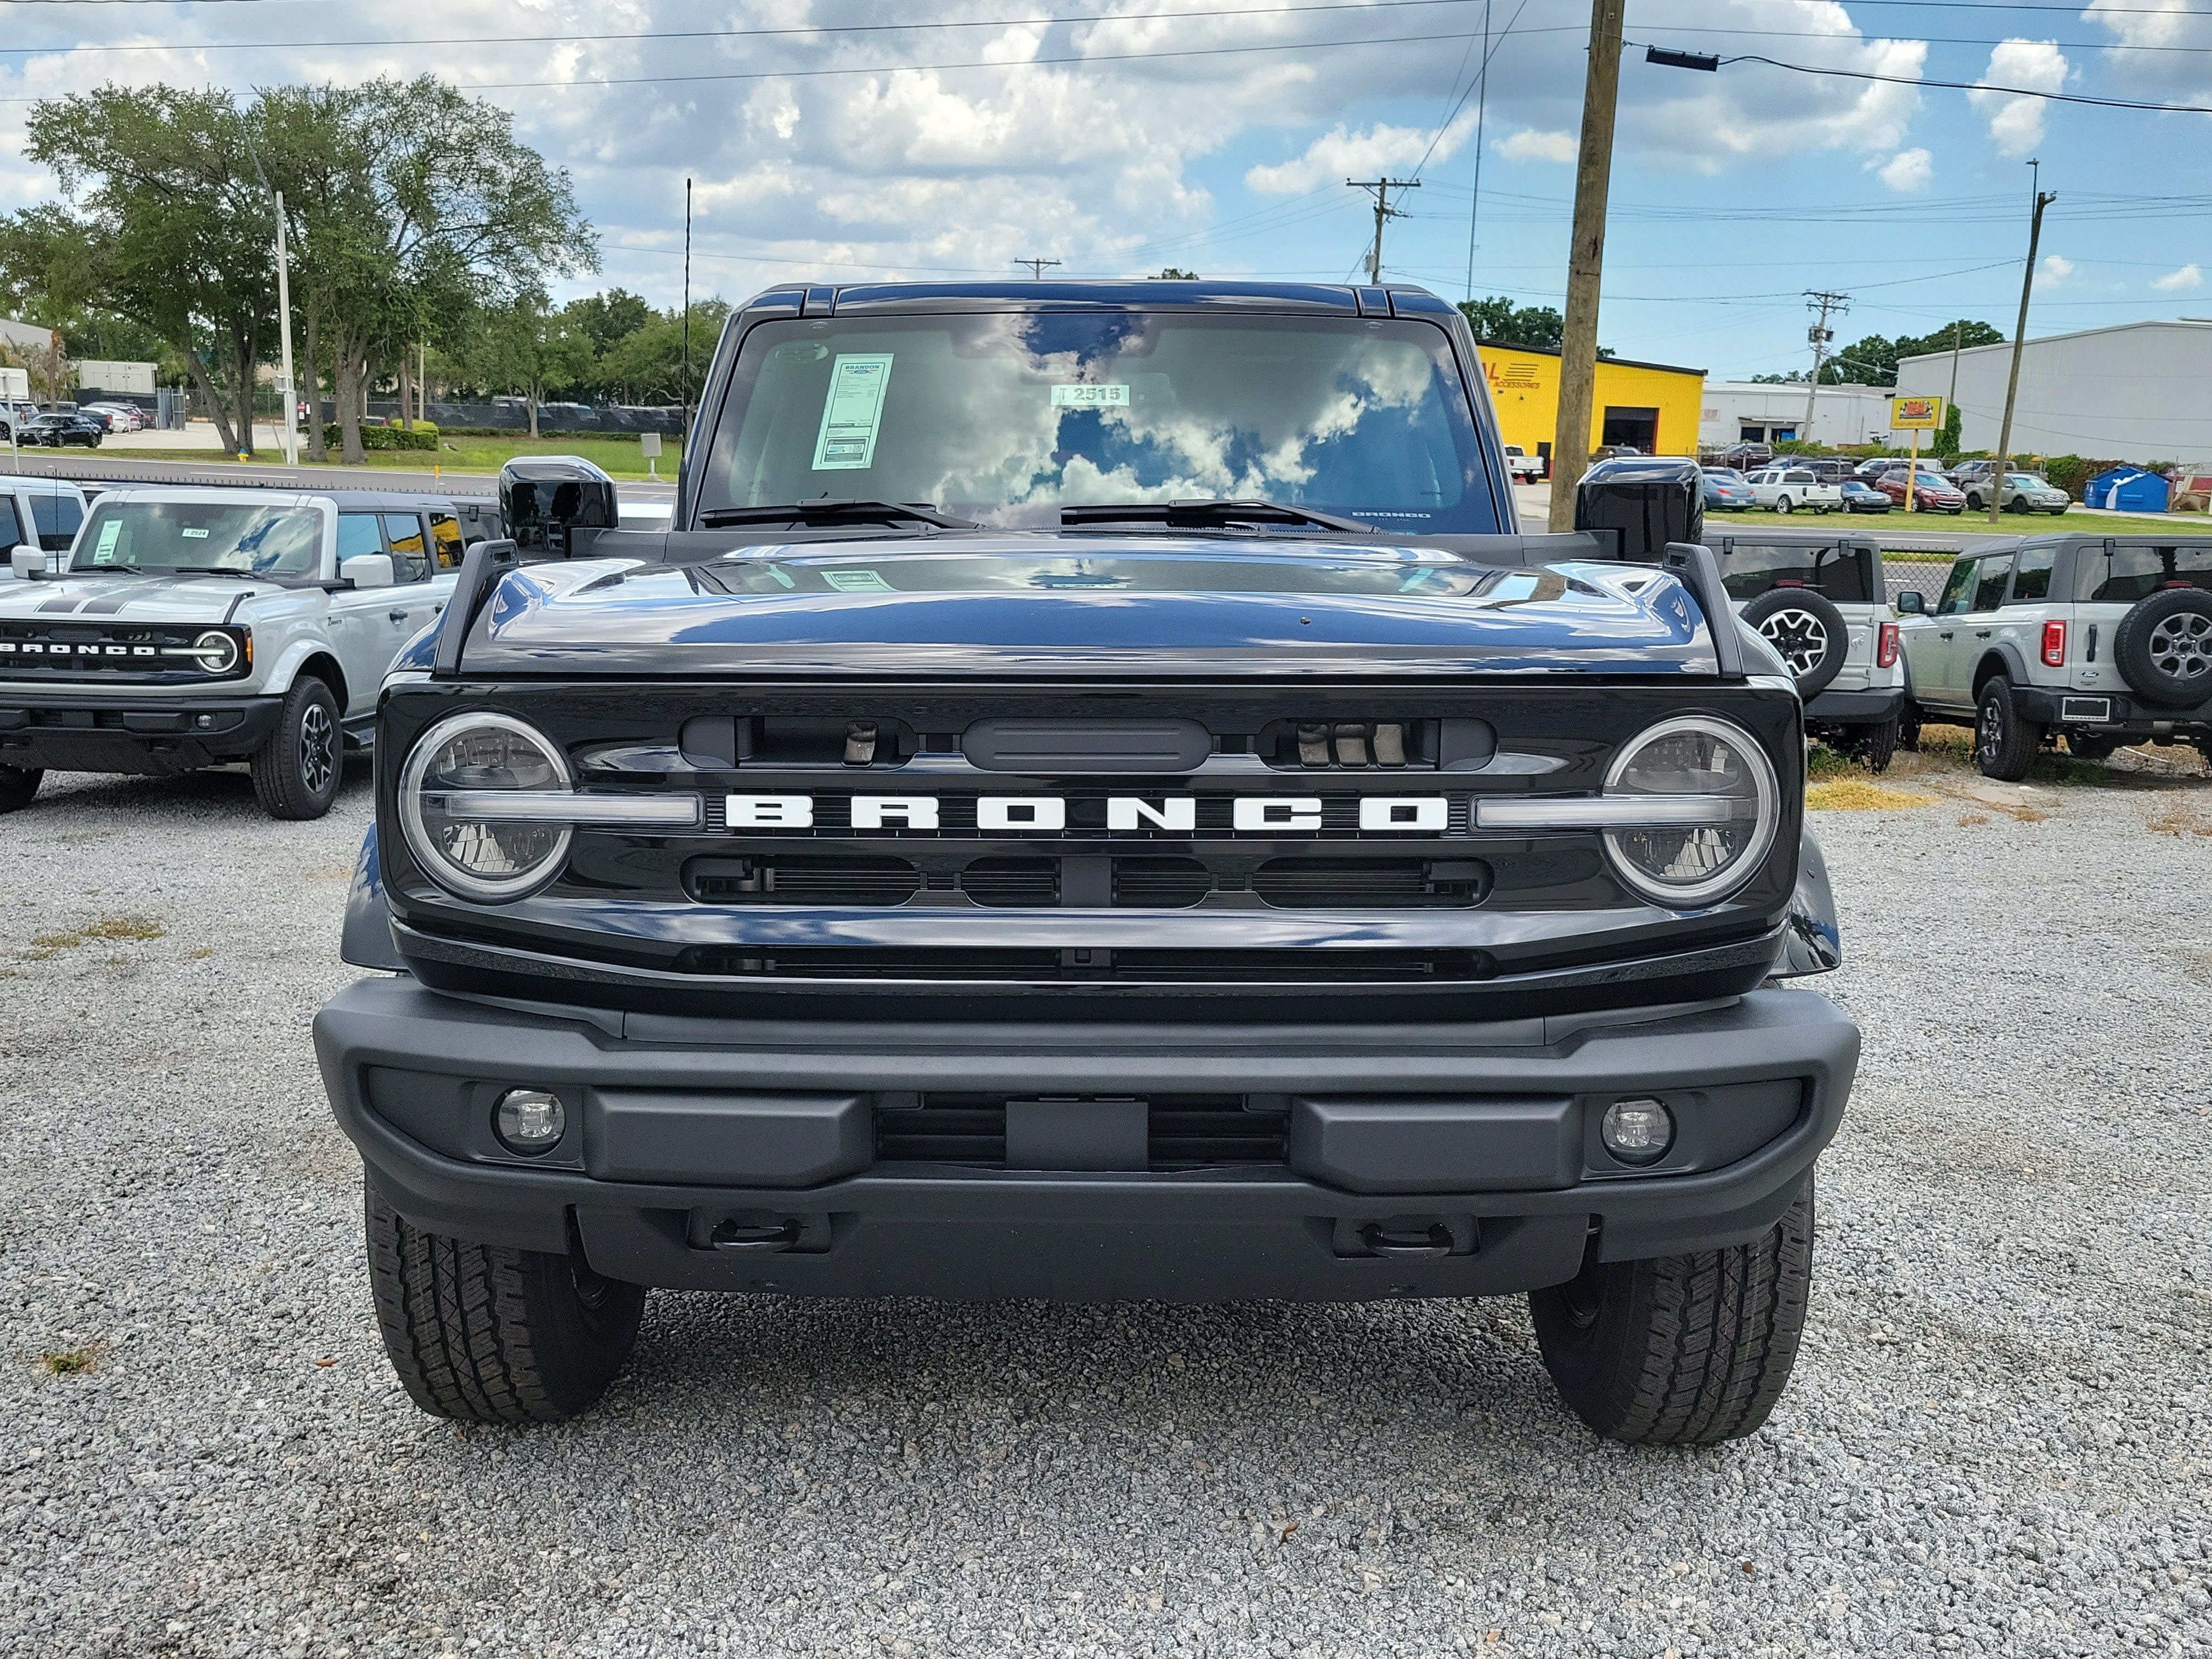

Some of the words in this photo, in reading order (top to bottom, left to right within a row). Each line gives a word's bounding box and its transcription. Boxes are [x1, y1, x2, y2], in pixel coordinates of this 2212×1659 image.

[1074, 388, 1121, 400] 2515
[0, 642, 155, 656] BRONCO
[726, 794, 1448, 830] BRONCO
